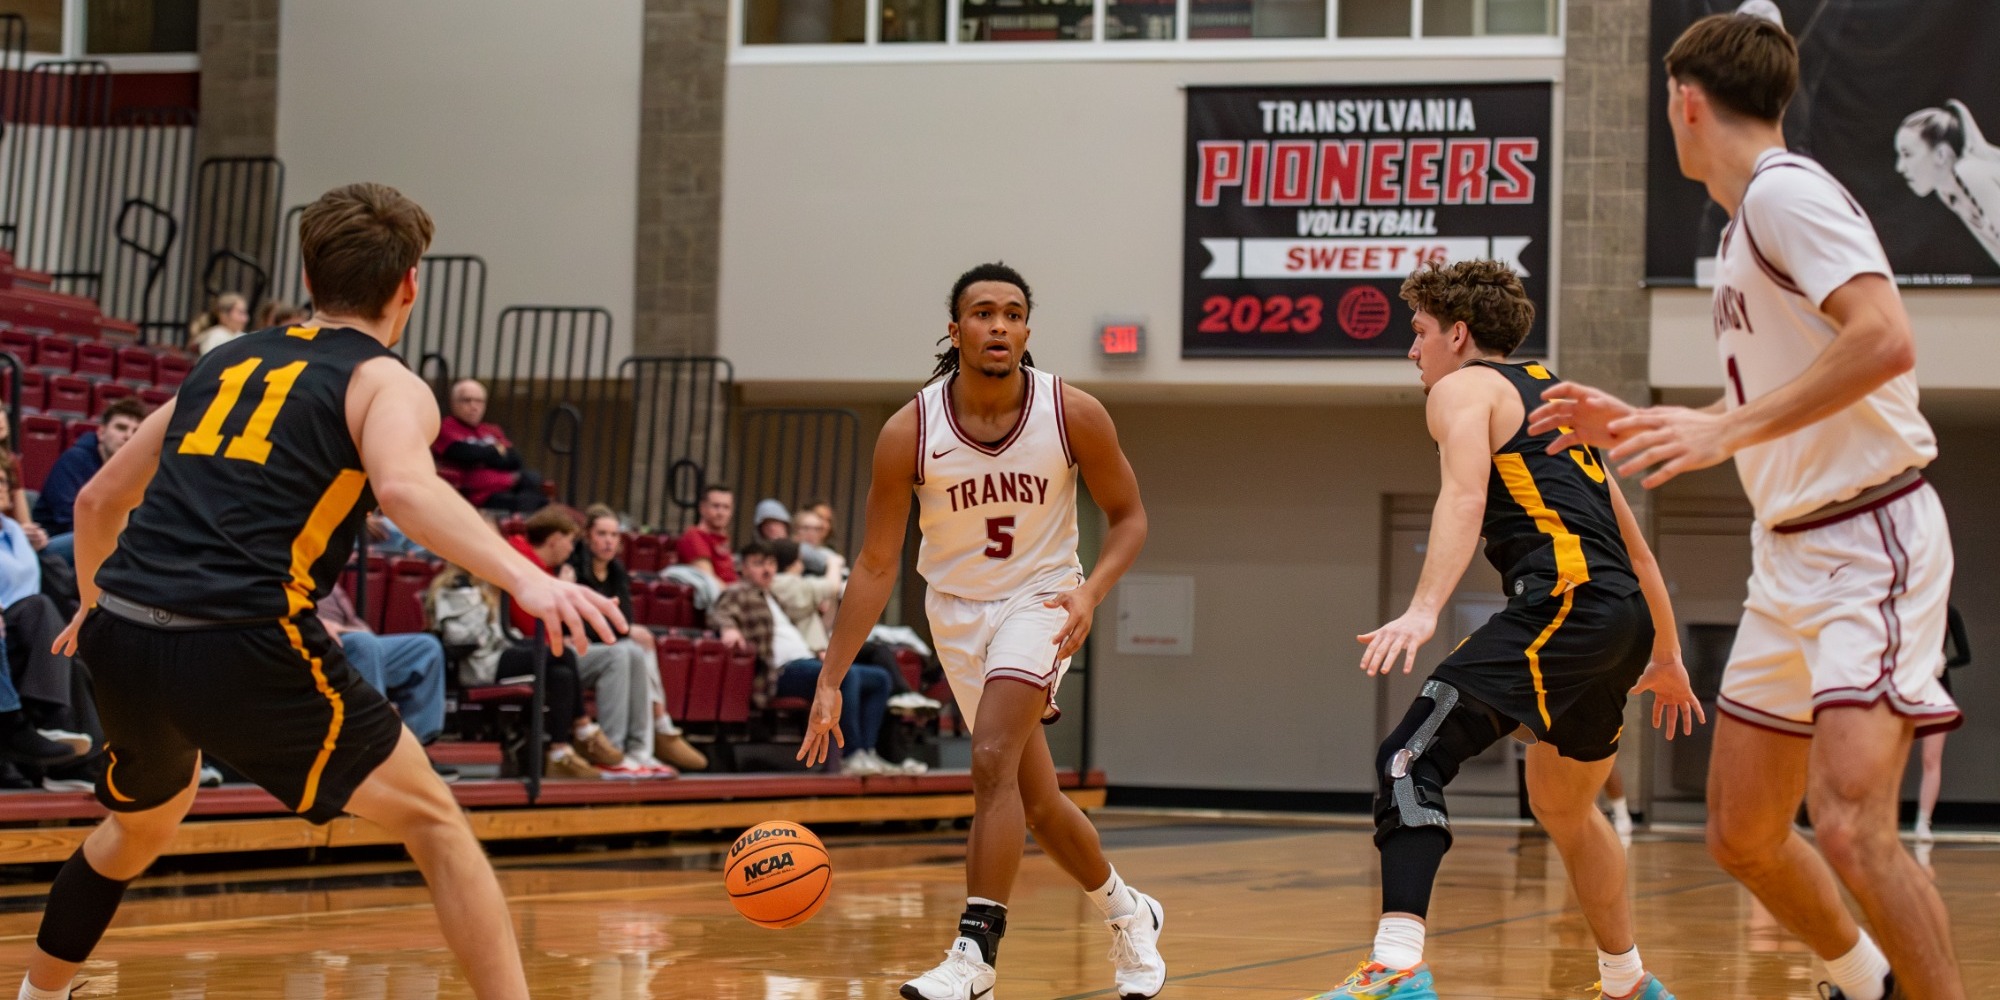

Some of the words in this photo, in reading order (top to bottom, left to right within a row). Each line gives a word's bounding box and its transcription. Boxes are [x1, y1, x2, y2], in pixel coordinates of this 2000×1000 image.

[1259, 98, 1476, 133] TRANSYLVANIA
[1196, 137, 1539, 206] PIONEERS
[1297, 209, 1438, 237] VOLLEYBALL
[1285, 247, 1408, 271] SWEET
[1198, 294, 1323, 334] 2023
[1104, 326, 1138, 353] EXIT
[178, 357, 309, 466] 11
[946, 472, 1049, 512] TRANSY
[984, 515, 1016, 561] 5
[731, 829, 797, 857] Wilson
[744, 852, 794, 881] NCAA
